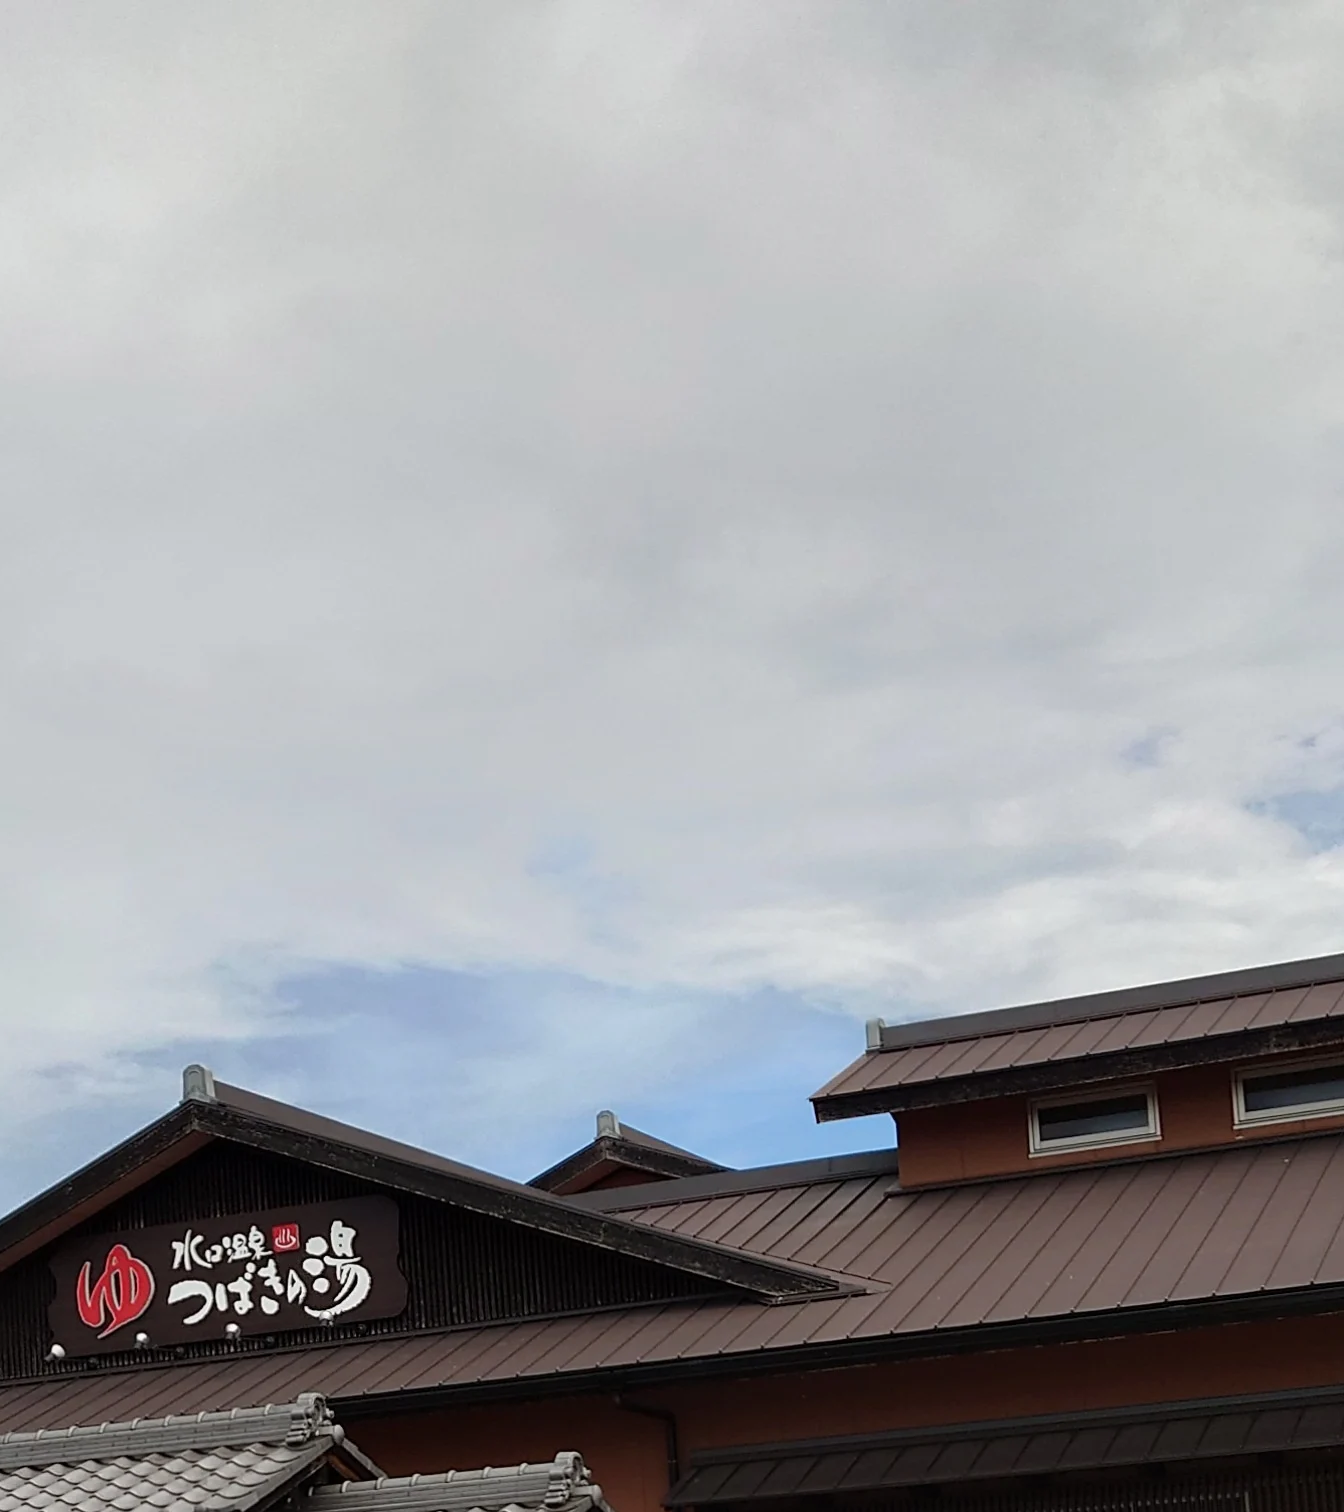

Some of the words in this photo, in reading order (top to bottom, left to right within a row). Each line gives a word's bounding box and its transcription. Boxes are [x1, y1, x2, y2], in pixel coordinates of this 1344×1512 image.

[77, 1244, 154, 1339] ゆ
[167, 1220, 372, 1325] つばきの湯
[171, 1224, 273, 1271] 水口温泉
